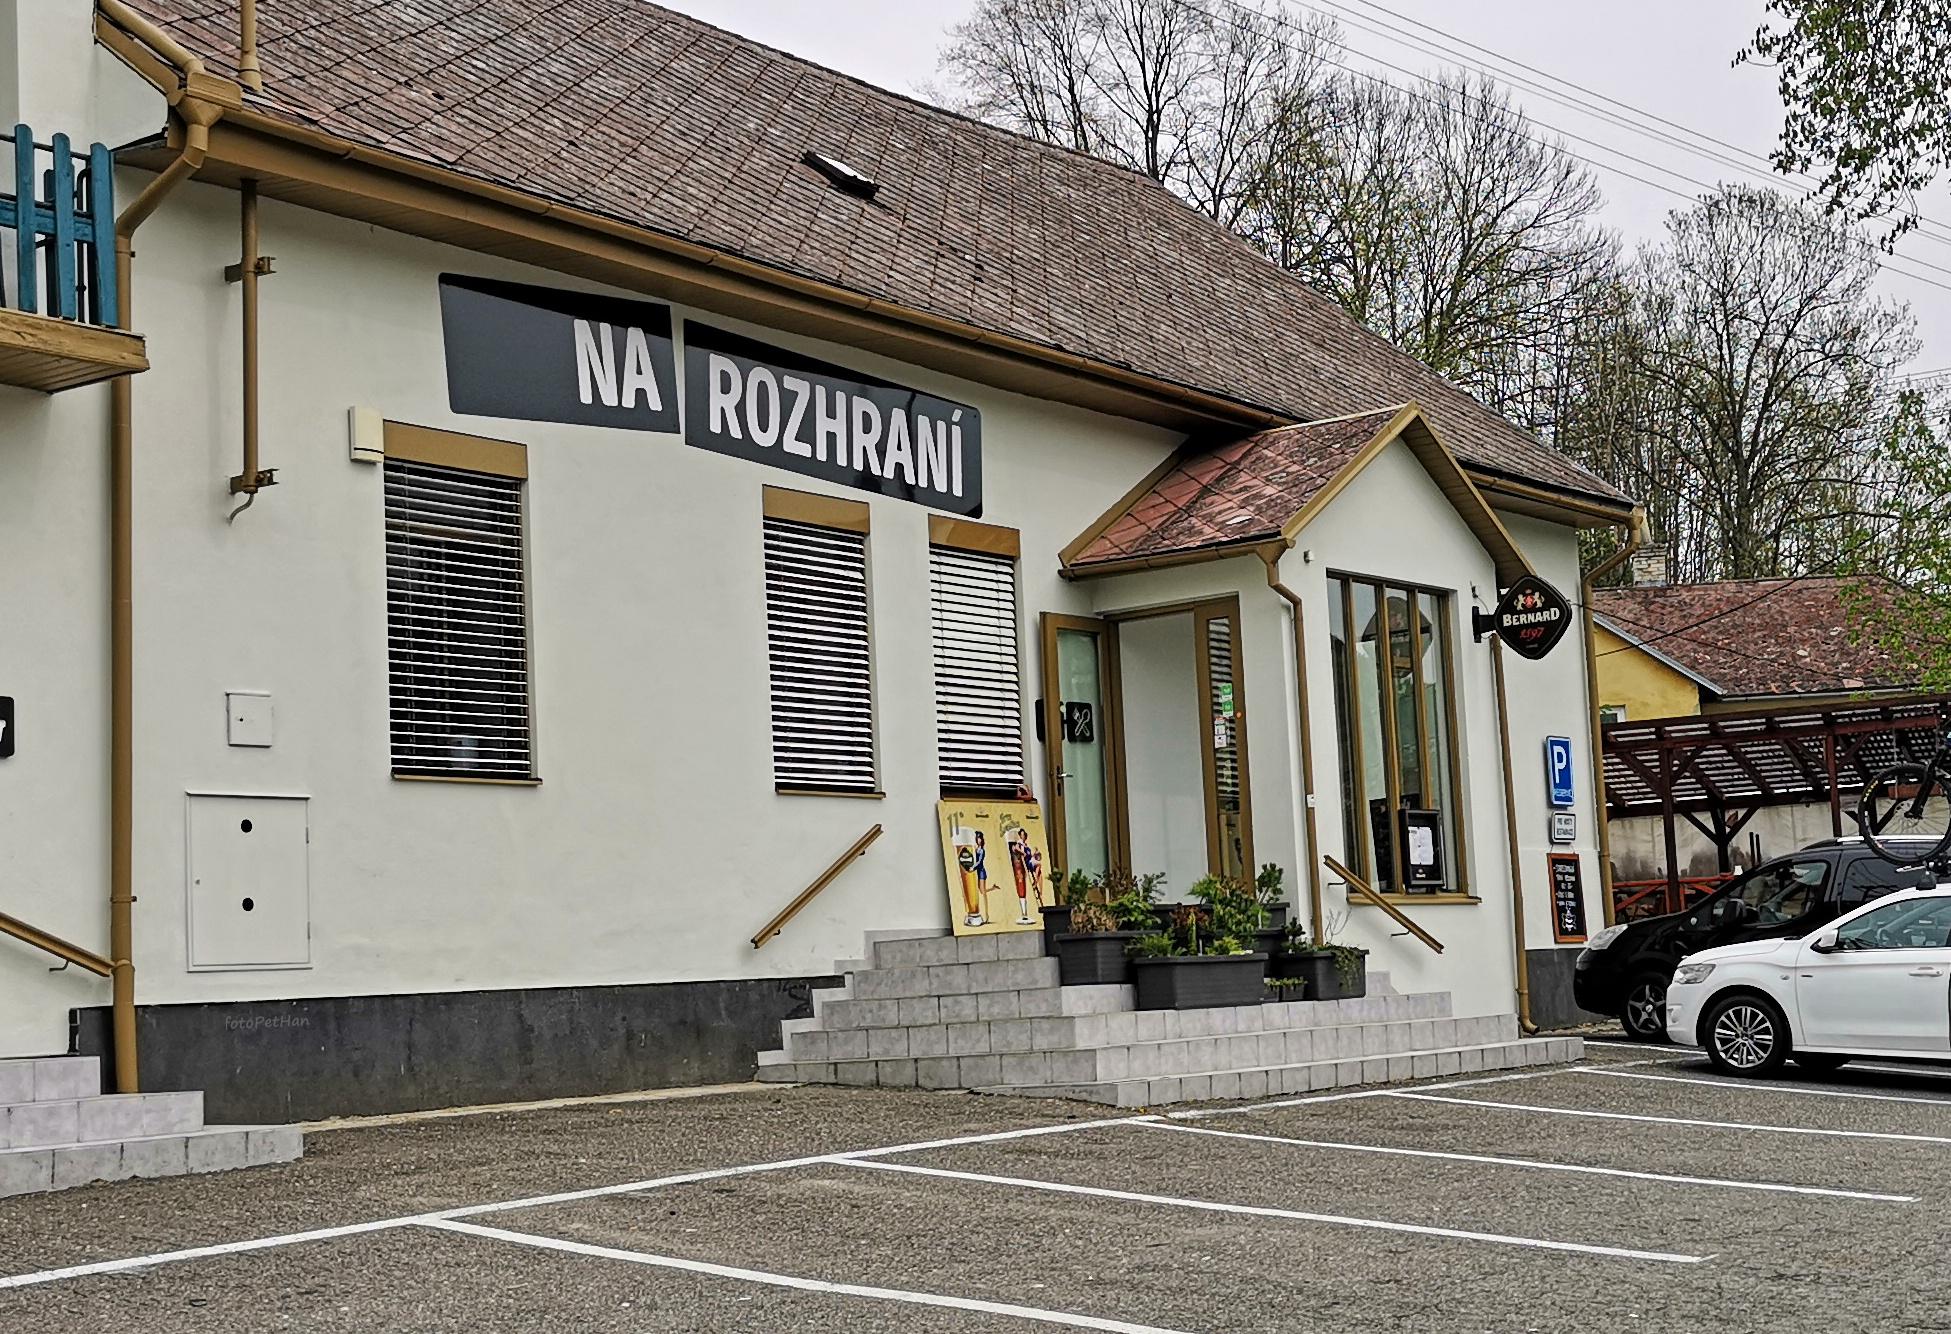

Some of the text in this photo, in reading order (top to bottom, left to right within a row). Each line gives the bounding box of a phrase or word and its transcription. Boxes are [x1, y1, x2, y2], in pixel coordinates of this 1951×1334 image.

[573, 318, 964, 498] NA ROZHRANÍ
[1502, 607, 1561, 627] BERNARD
[1553, 745, 1567, 784] P
